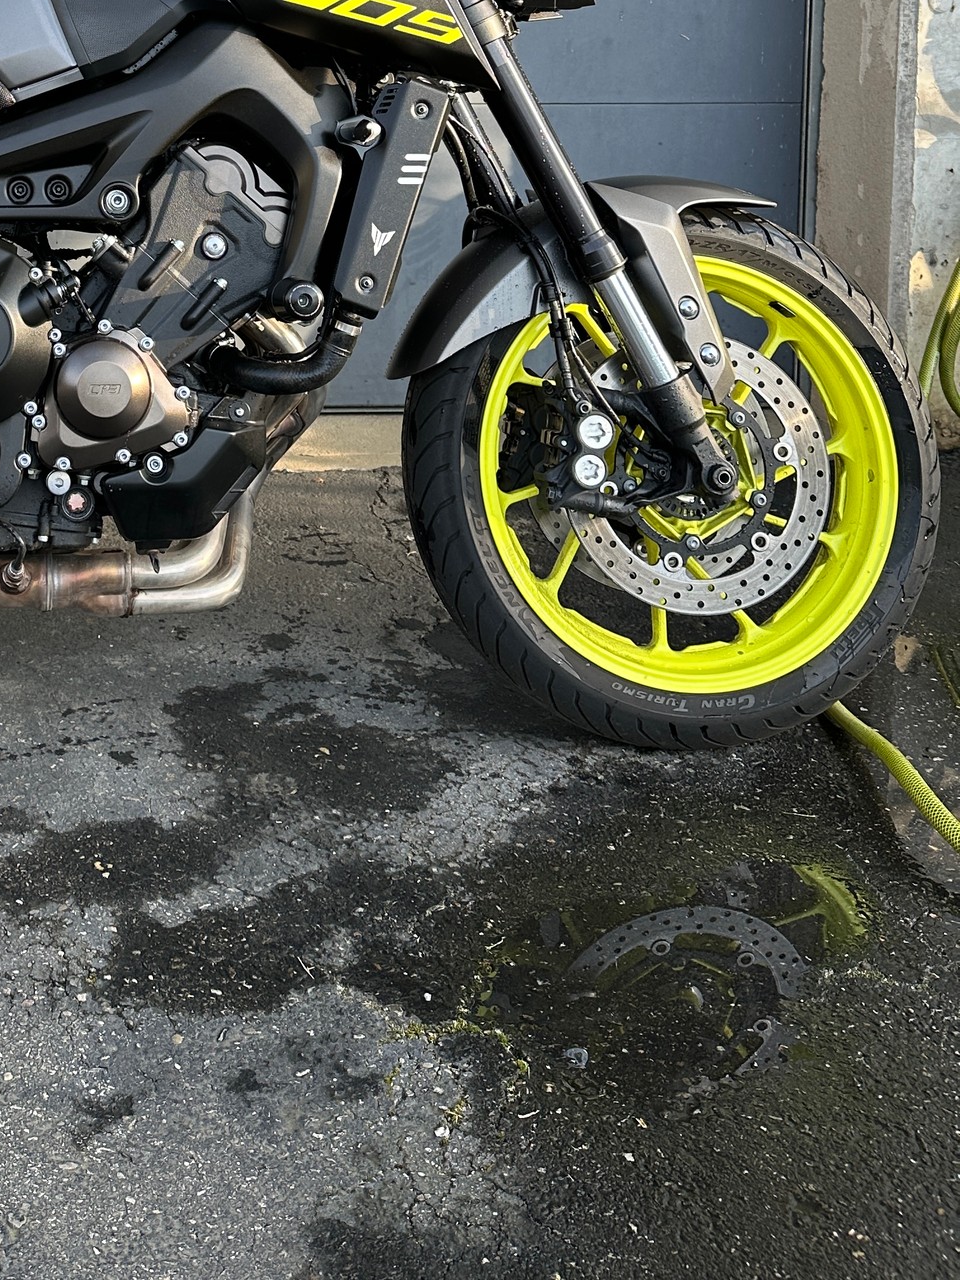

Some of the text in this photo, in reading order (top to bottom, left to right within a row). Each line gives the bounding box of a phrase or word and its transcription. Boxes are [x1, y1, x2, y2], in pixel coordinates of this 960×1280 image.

[830, 599, 886, 666] PIRELLI
[610, 681, 756, 712] GRAN TURISMO
